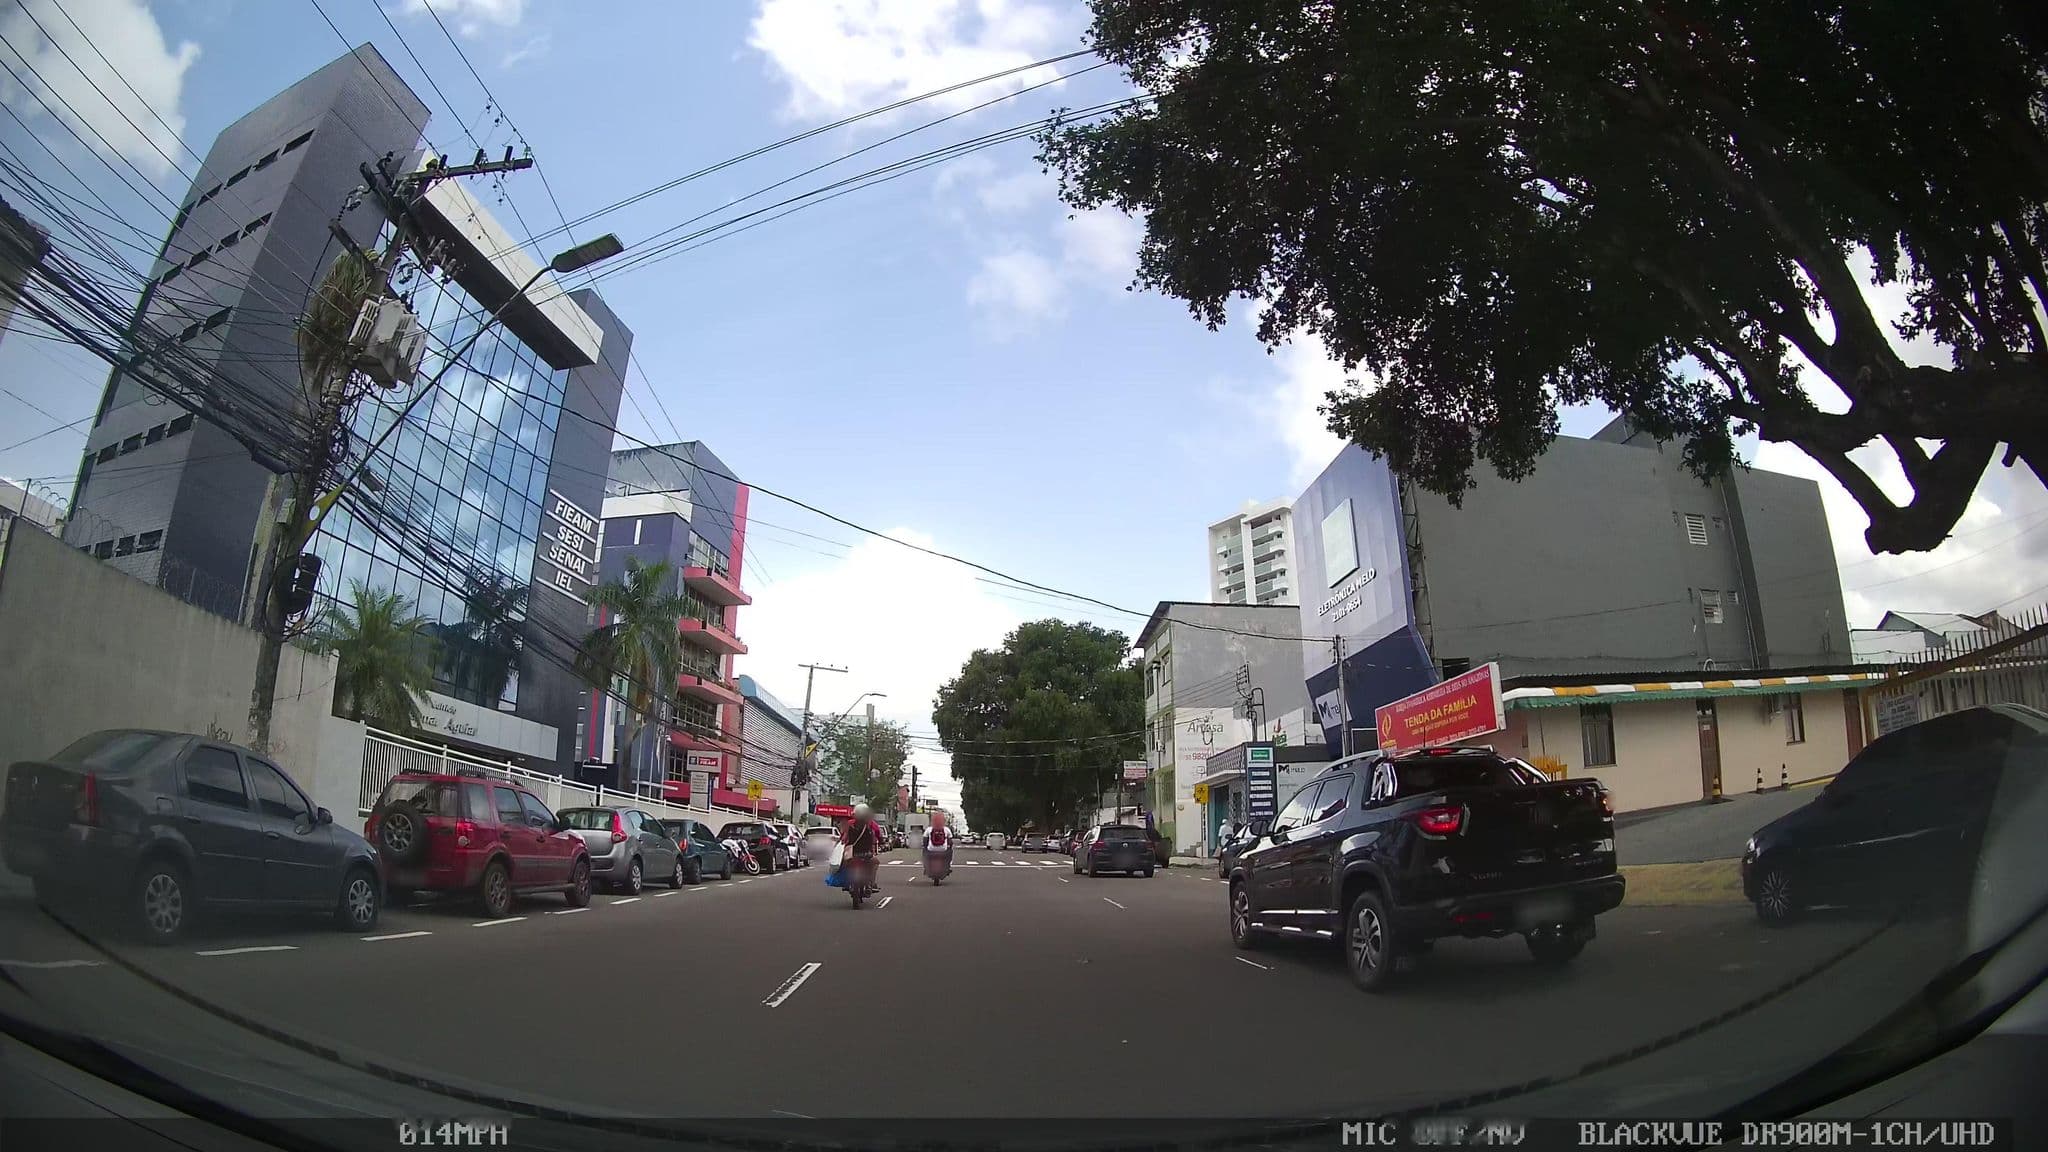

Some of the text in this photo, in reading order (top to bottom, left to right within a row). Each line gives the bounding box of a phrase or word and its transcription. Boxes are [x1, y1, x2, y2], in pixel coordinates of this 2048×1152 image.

[555, 500, 592, 533] FIEAM
[557, 525, 584, 551] SESI
[549, 545, 586, 574] SENAI
[555, 570, 573, 591] IEL
[1404, 694, 1477, 728] TENDA DA FAMÍLIA
